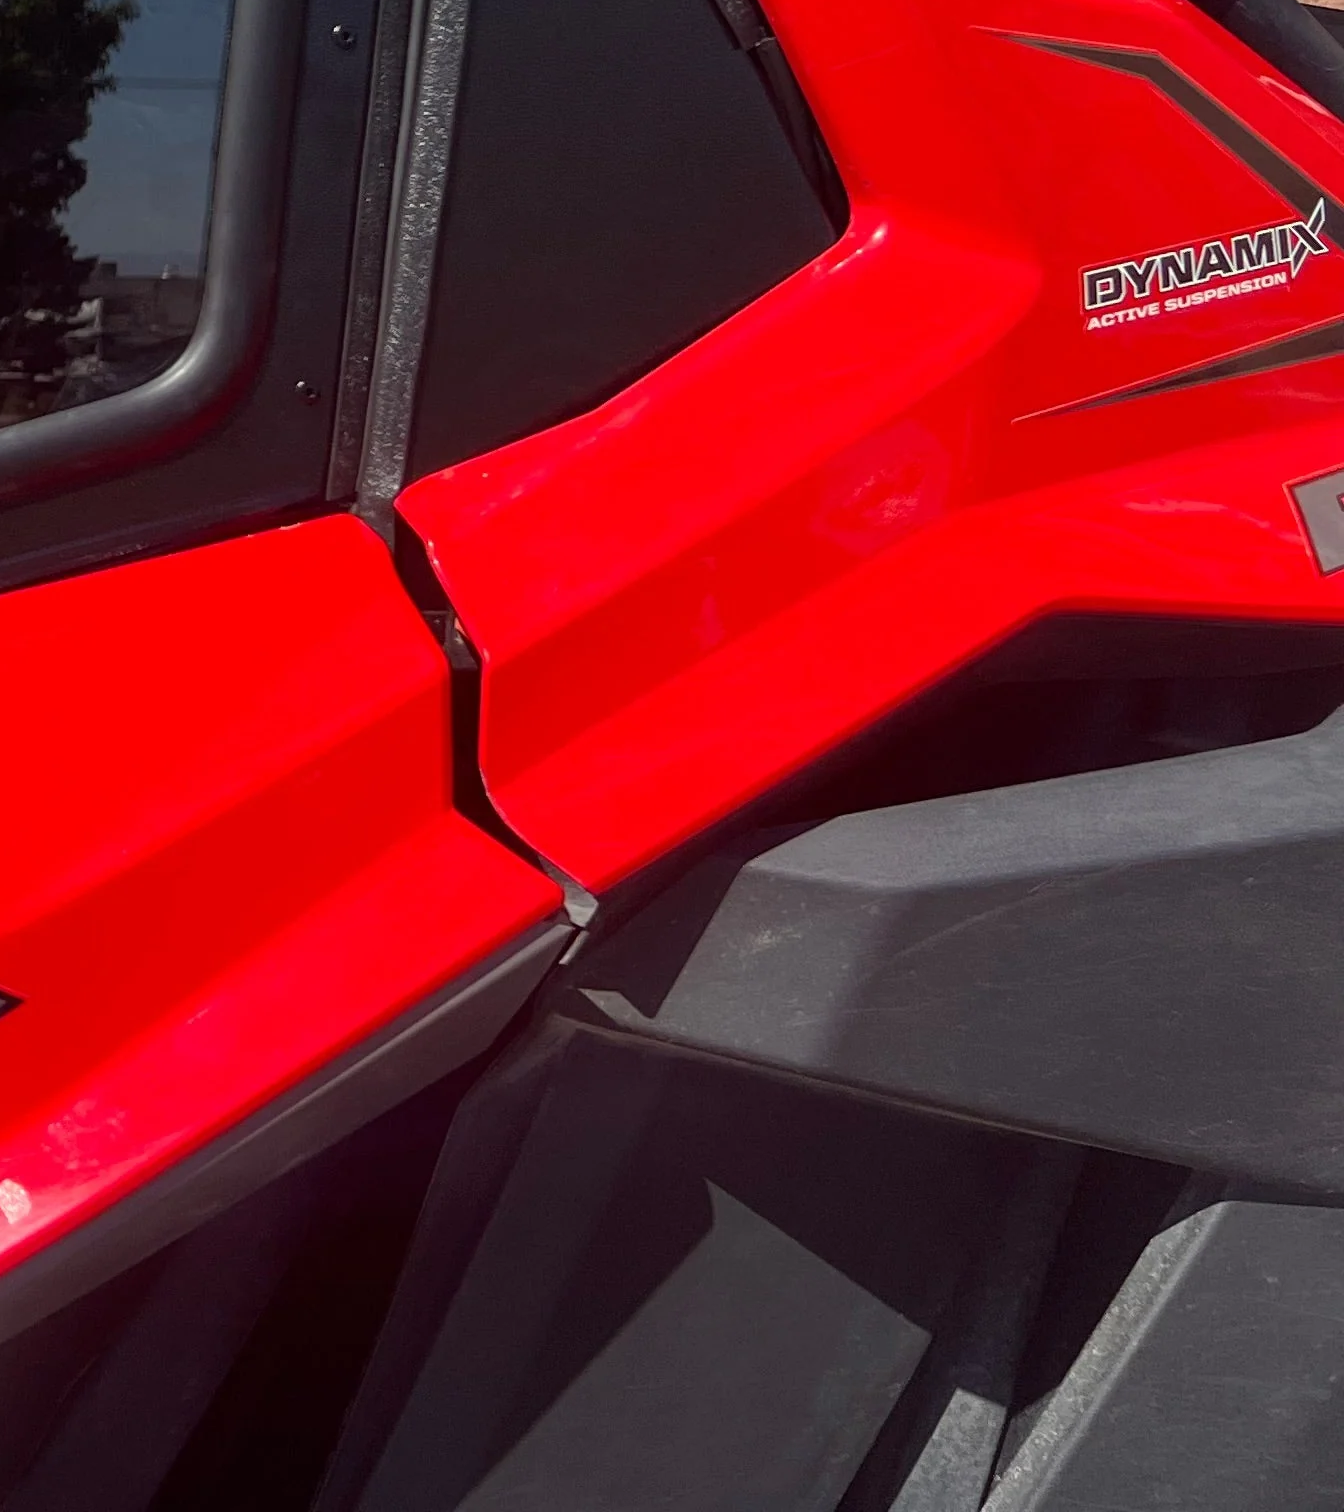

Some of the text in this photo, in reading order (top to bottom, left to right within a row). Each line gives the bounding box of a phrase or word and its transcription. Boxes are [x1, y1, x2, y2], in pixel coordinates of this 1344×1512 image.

[1083, 196, 1329, 311] DYNAMIX
[1087, 271, 1287, 331] ACTIVE SUSPENSION
